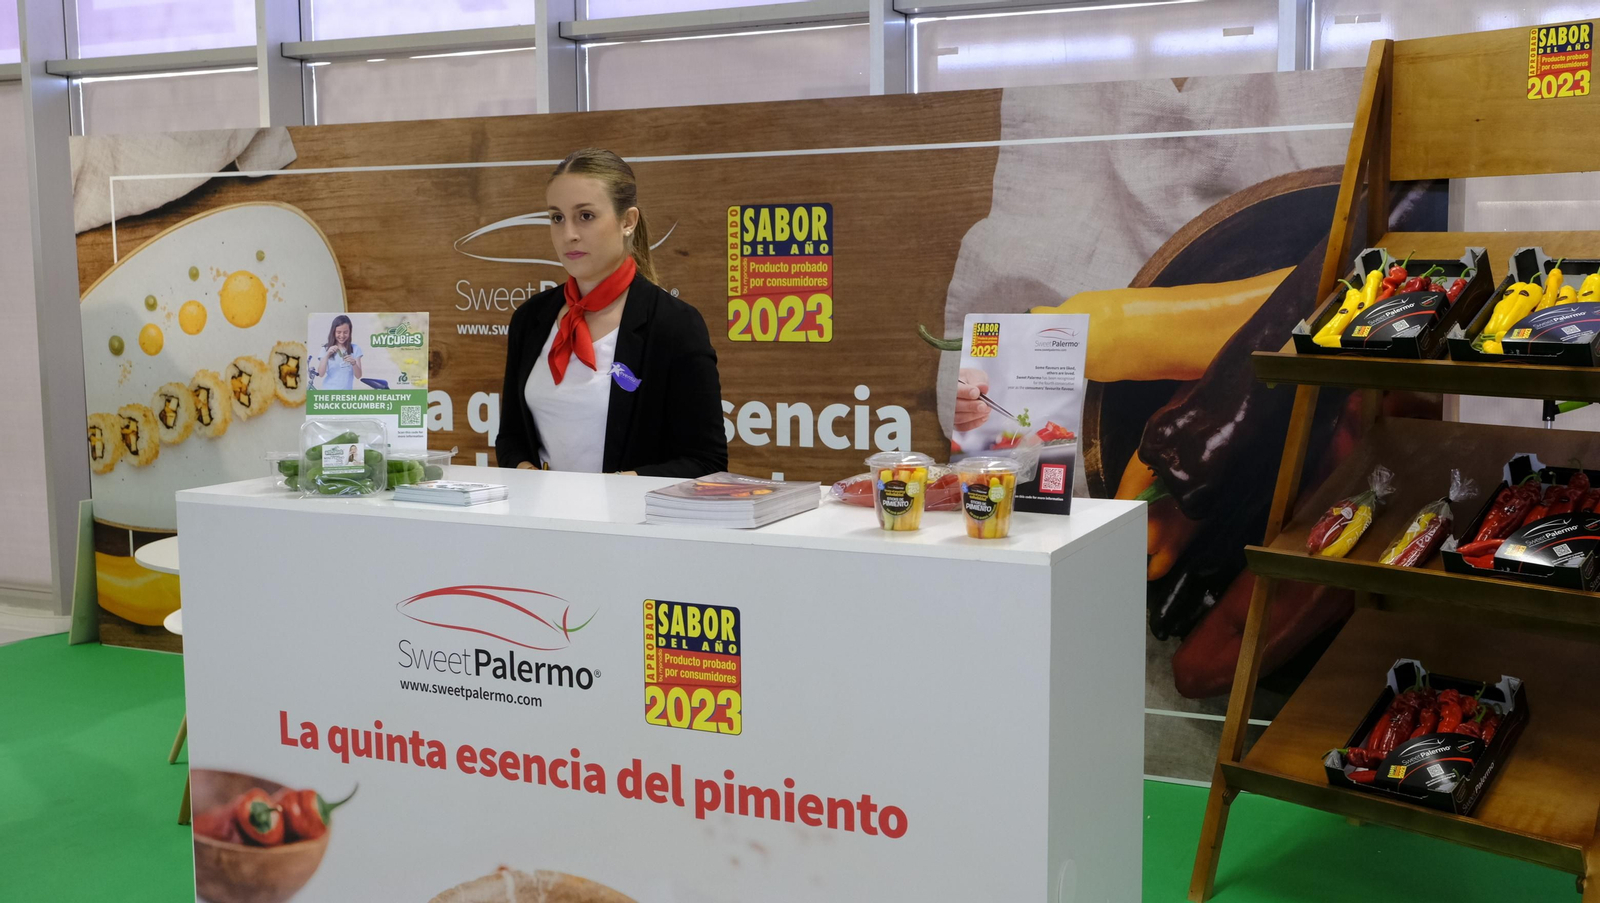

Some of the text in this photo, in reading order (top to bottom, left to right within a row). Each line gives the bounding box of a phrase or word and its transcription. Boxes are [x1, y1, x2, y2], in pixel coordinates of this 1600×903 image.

[1539, 24, 1589, 47] SABOR
[1529, 30, 1537, 74] APROBADO
[1566, 43, 1590, 51] AÑO
[1567, 53, 1588, 61] probado
[1551, 61, 1588, 70] consumidores
[1527, 70, 1591, 99] 2023
[743, 206, 828, 242] SABOR
[730, 209, 739, 294] APROBADO
[743, 241, 829, 255] DEL AÑO
[750, 261, 828, 274] Producto probado
[750, 276, 828, 288] por consumidores
[728, 293, 833, 342] 2023
[977, 324, 999, 332] SABOR
[971, 345, 998, 357] 2023
[313, 402, 340, 410] SNACK
[427, 390, 453, 432] a
[721, 384, 911, 452] sencia
[965, 503, 992, 512] PIMIENTO
[658, 603, 736, 641] SABOR
[645, 602, 655, 681] APROBADO
[659, 637, 737, 654] DEL AÑO
[665, 653, 737, 671] Producto probado
[665, 668, 737, 684] por consumidores
[400, 680, 542, 707] www.sweetpalermo.com
[645, 685, 741, 736] 2023
[279, 710, 908, 839] La quinta esencia del pimiento
